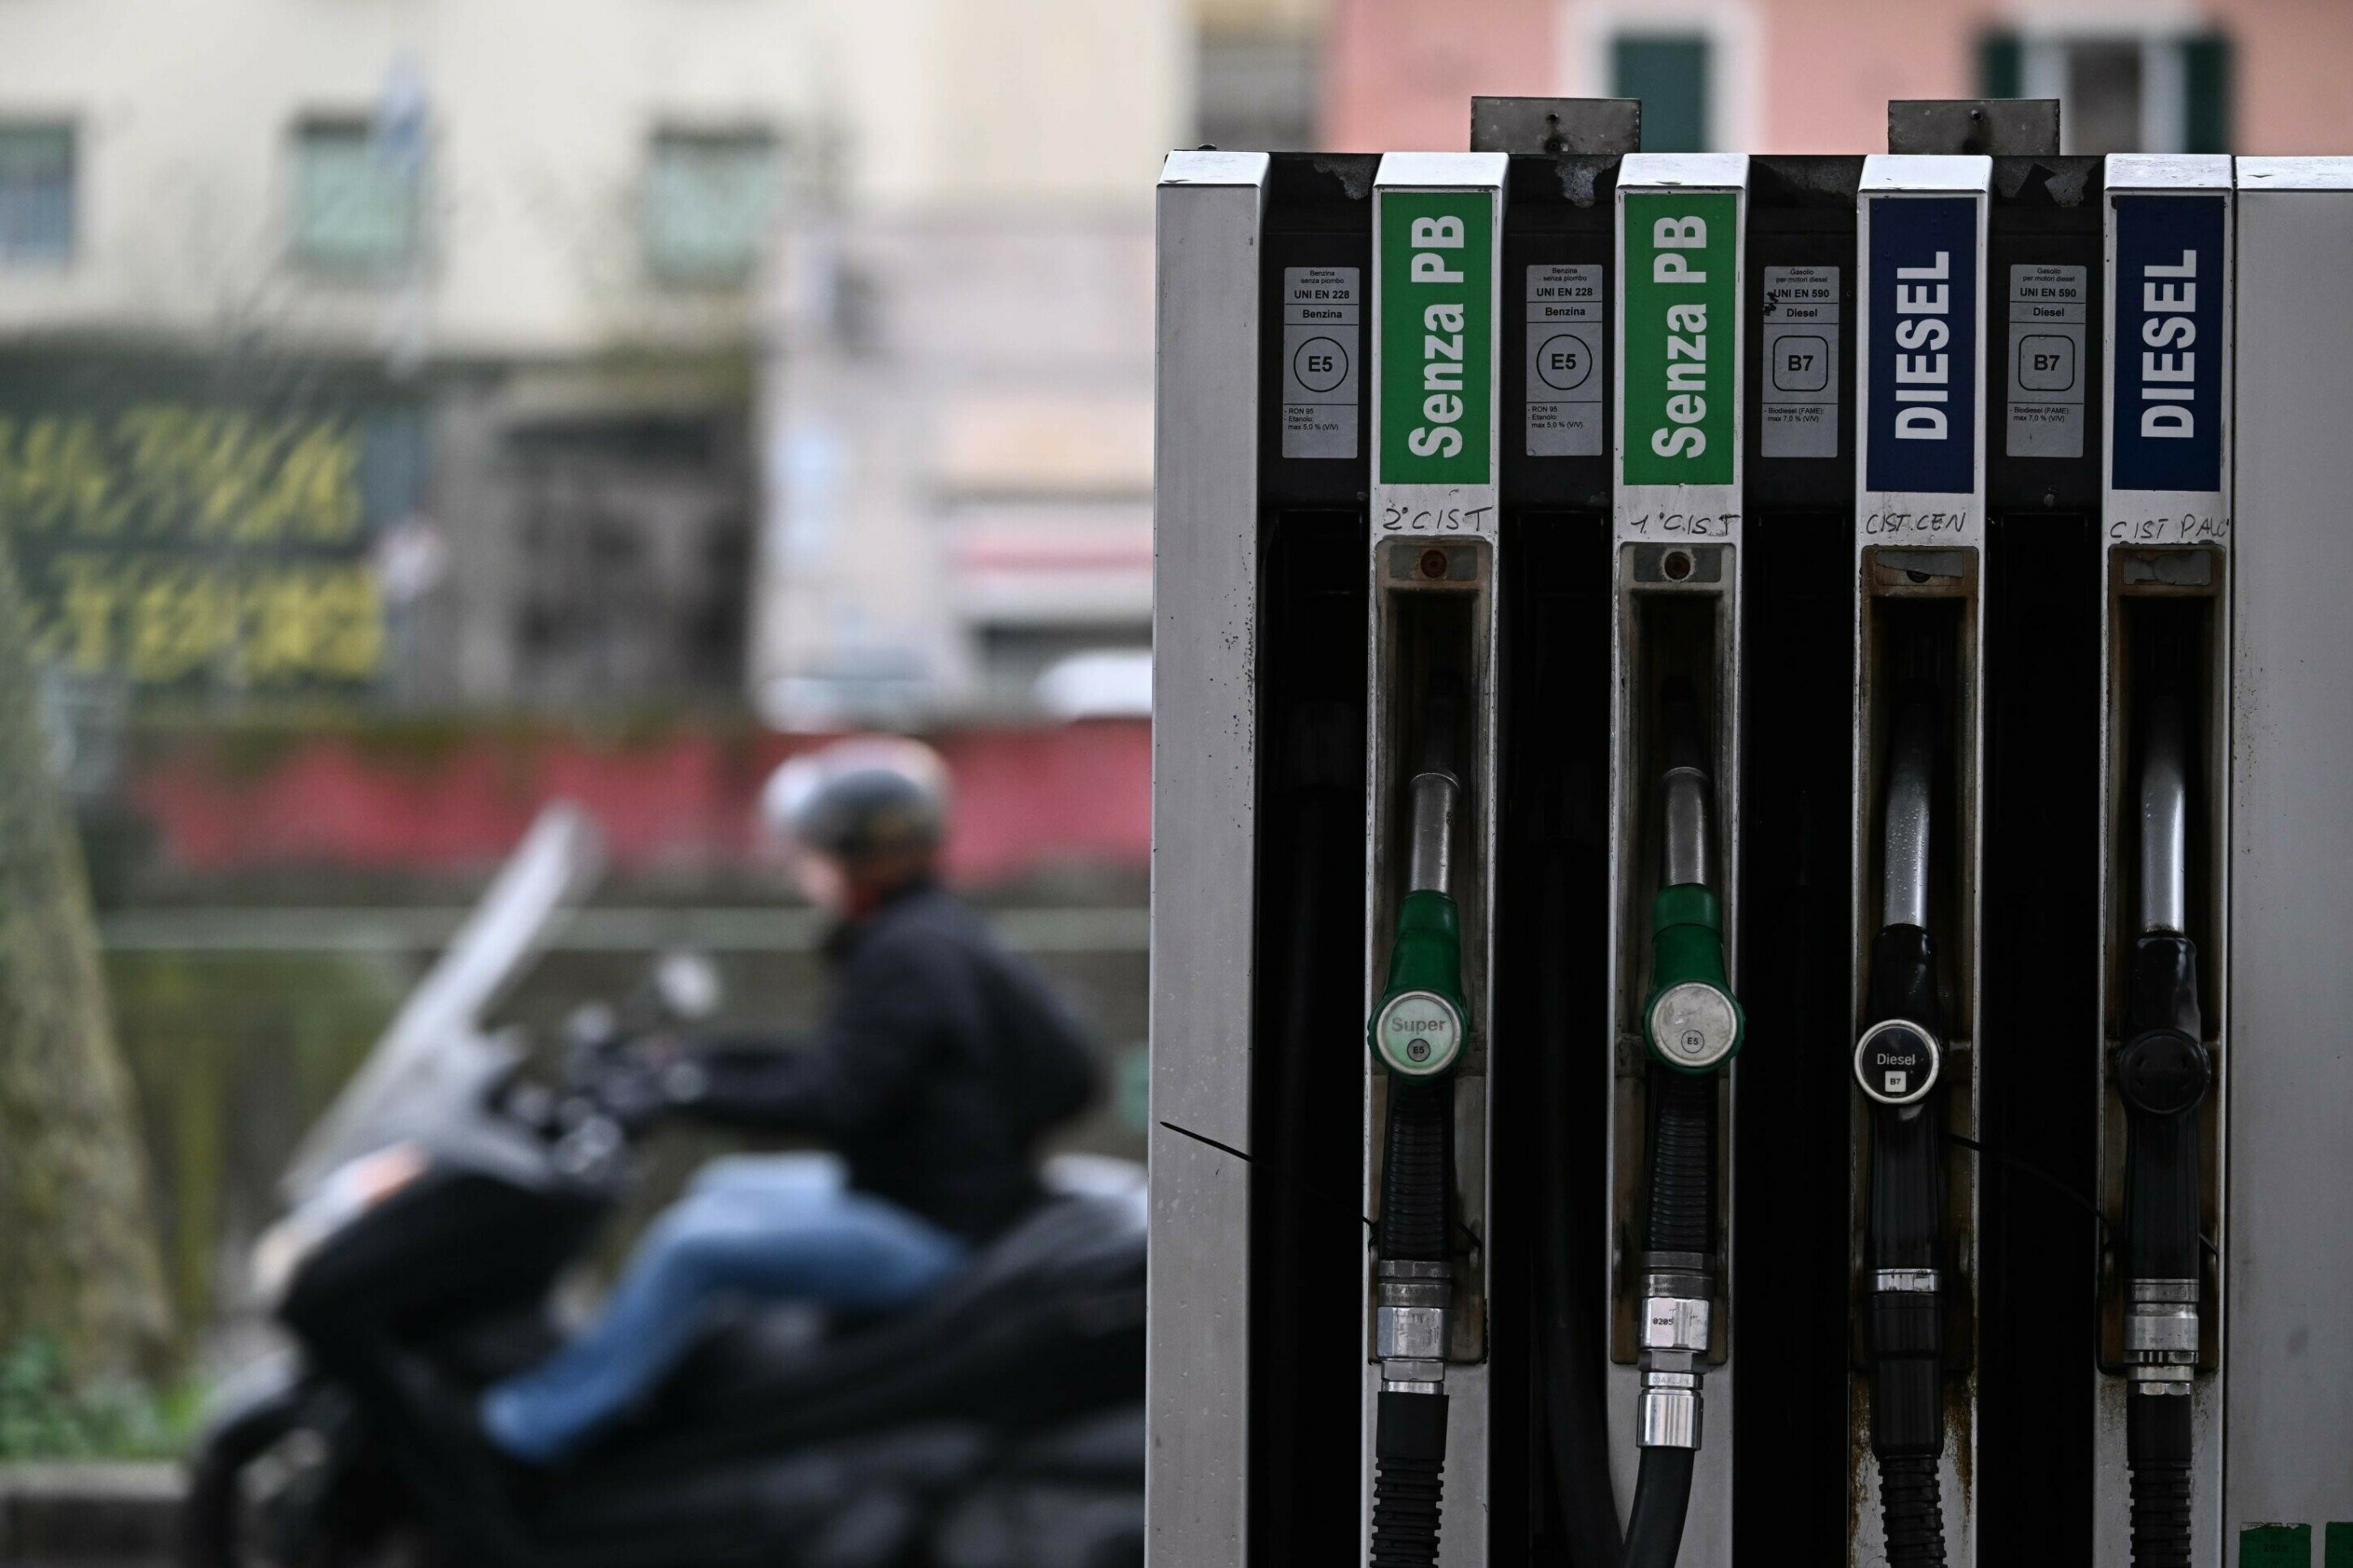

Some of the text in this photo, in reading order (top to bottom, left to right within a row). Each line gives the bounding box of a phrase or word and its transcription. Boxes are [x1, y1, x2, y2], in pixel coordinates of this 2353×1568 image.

[1294, 290, 1349, 299] UNI EN 228
[1536, 287, 1593, 296] UNI EN 228
[1774, 289, 1830, 298] UNI EN 590
[2020, 287, 2076, 298] UNI EN 590
[1302, 309, 1342, 319] Benzina
[1545, 307, 1585, 316] Benzina
[1787, 308, 1817, 317] Diesel
[2033, 307, 2064, 316] Diesel
[1409, 215, 1465, 458] Senza PB
[1651, 215, 1707, 458] Senza PB
[1895, 251, 1950, 440] DIESEL
[2140, 250, 2196, 438] DIESEL
[1308, 355, 1333, 372] E5
[1551, 353, 1577, 370] E5
[1788, 354, 1813, 372] B7
[2034, 354, 2060, 372] B7
[2110, 518, 2169, 539] CIST
[1392, 1017, 1447, 1035] Super
[1413, 1046, 1425, 1054] E5
[1877, 1054, 1916, 1065] Diesel
